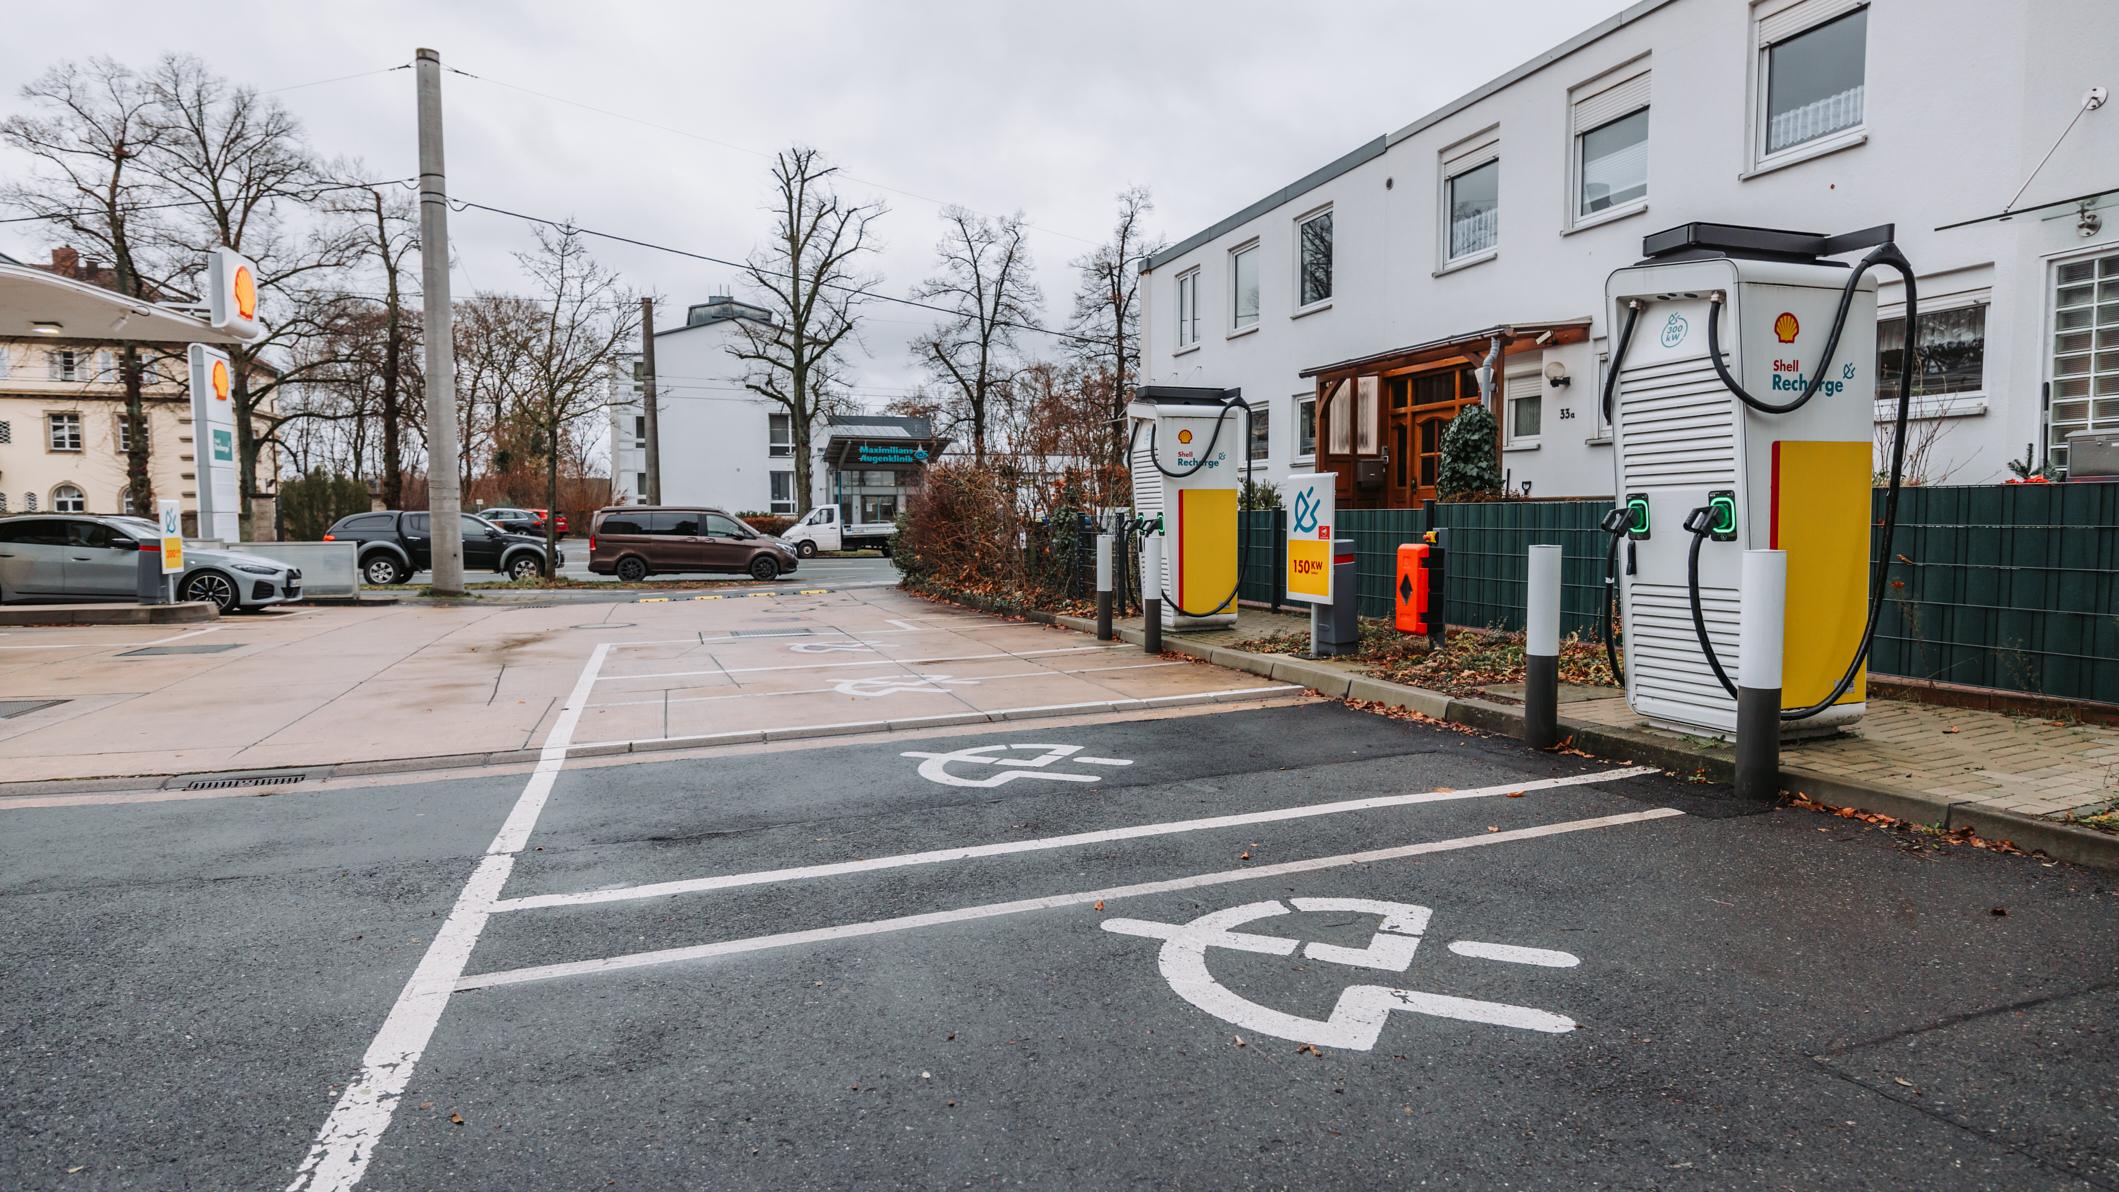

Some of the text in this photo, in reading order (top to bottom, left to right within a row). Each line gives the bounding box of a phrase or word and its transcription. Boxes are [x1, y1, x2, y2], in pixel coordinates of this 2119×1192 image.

[1667, 325, 1683, 334] 300
[1773, 359, 1799, 372] Shell
[1772, 373, 1844, 397] Rechrge
[1559, 408, 1575, 420] 33a
[859, 446, 913, 455] Maximilians
[1177, 450, 1193, 458] Shell
[859, 455, 913, 464] Augenklinik
[1177, 458, 1220, 469] Rechrge
[1293, 559, 1323, 574] 150 KW
